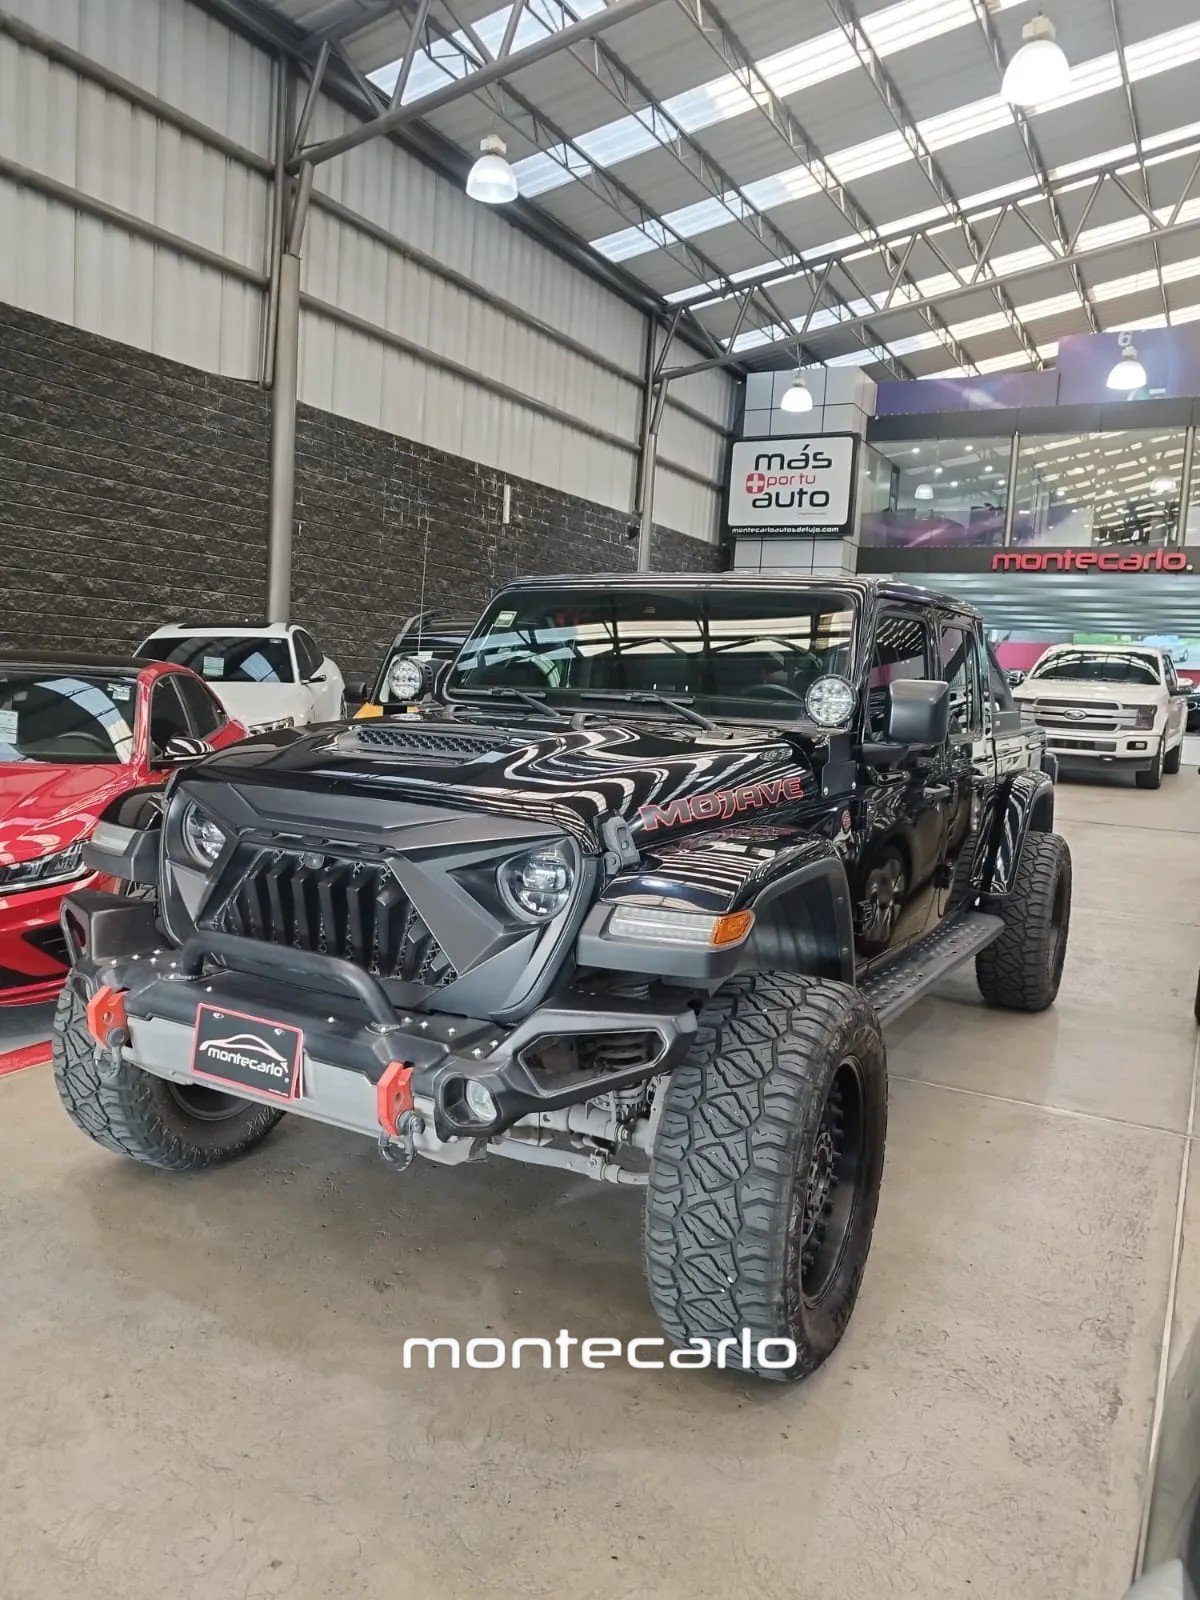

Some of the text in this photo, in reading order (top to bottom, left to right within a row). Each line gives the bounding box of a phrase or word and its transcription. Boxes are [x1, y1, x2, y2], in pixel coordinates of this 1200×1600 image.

[754, 444, 833, 471] más
[766, 473, 817, 489] por tu
[751, 487, 830, 509] auto
[638, 776, 804, 832] MOJAVE
[207, 1046, 284, 1078] montecarlo
